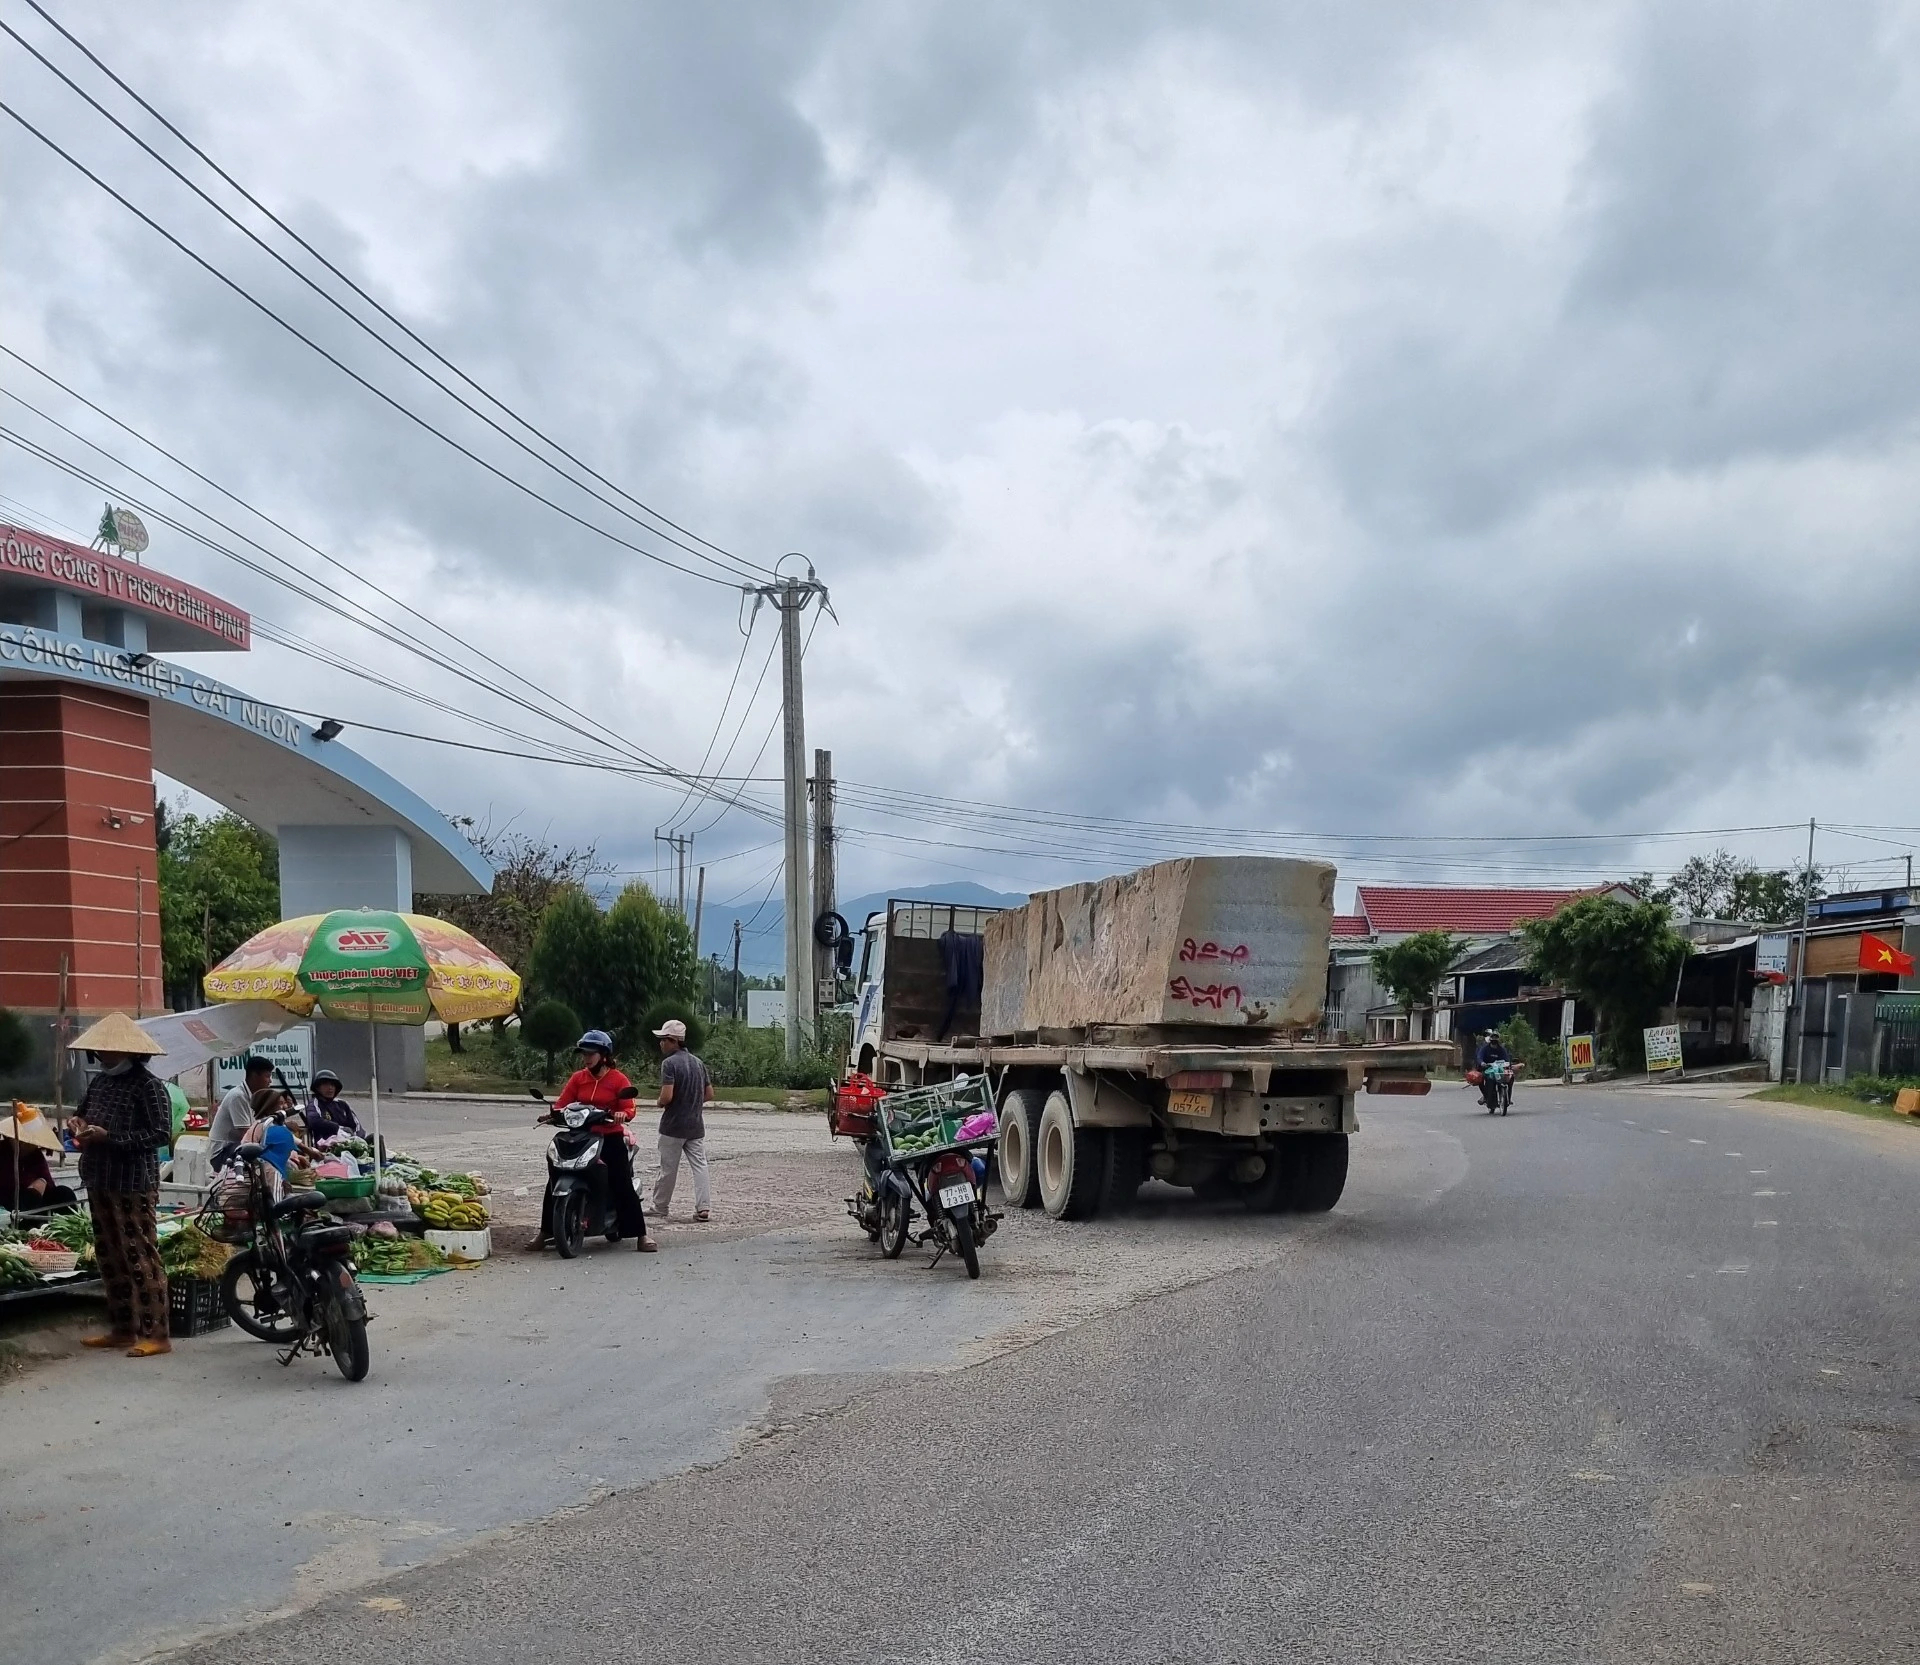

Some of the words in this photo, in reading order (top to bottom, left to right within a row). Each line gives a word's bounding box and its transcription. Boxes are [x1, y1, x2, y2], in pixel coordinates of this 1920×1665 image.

[0, 532, 46, 573] TỔNG
[50, 547, 99, 588] CÔNG
[103, 564, 124, 595] TY
[127, 573, 176, 612] PISICO
[177, 587, 210, 626] BÌNH
[213, 608, 246, 642] ĐỊNH
[0, 628, 83, 672] CÔNG
[92, 648, 185, 697] NGHIỆP
[191, 680, 233, 715] CÁT
[241, 701, 300, 746] NHƠN
[1571, 1041, 1592, 1065] CƠM
[1183, 1093, 1201, 1104] 77C
